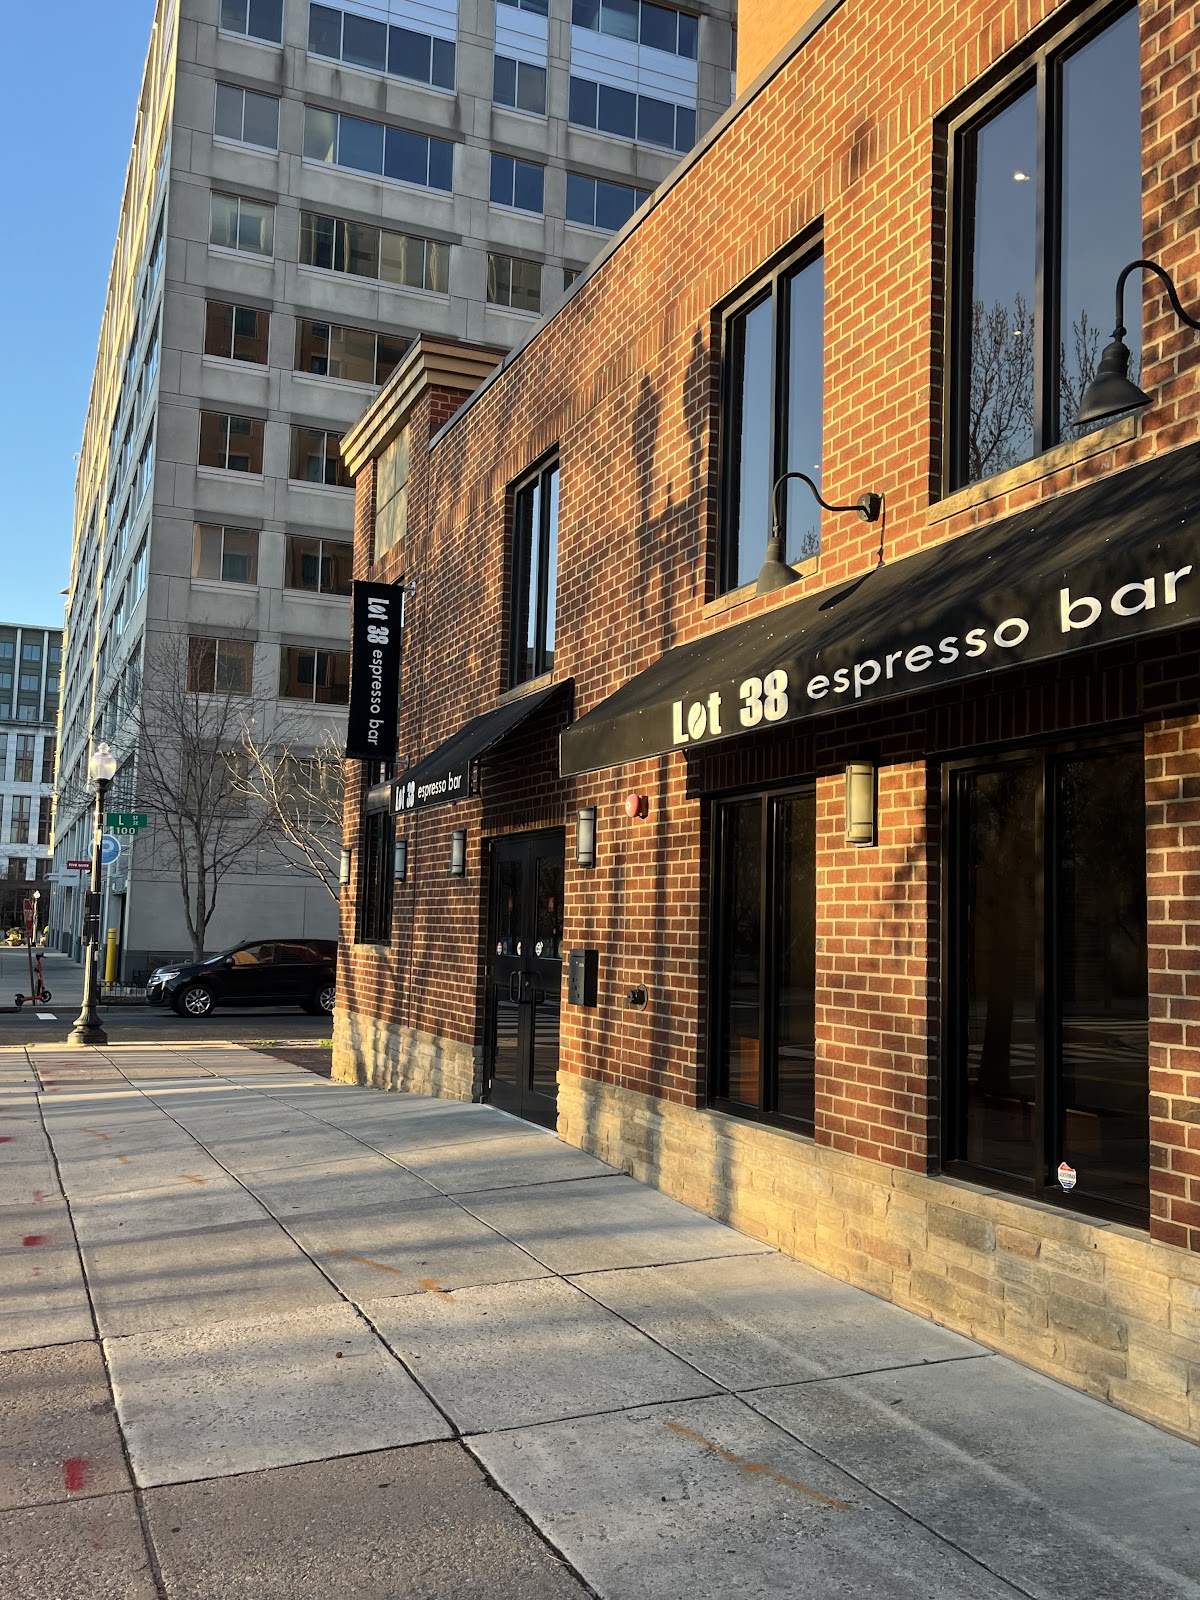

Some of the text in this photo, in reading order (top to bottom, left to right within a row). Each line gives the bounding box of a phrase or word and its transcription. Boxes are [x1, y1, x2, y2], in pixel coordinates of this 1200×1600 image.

[367, 597, 390, 746] Lot 38 espresso bar
[672, 564, 1194, 745] Lot 38 espresso bar
[395, 771, 463, 812] Lot 38 espresso bar
[116, 827, 136, 835] 100
[118, 814, 124, 825] L
